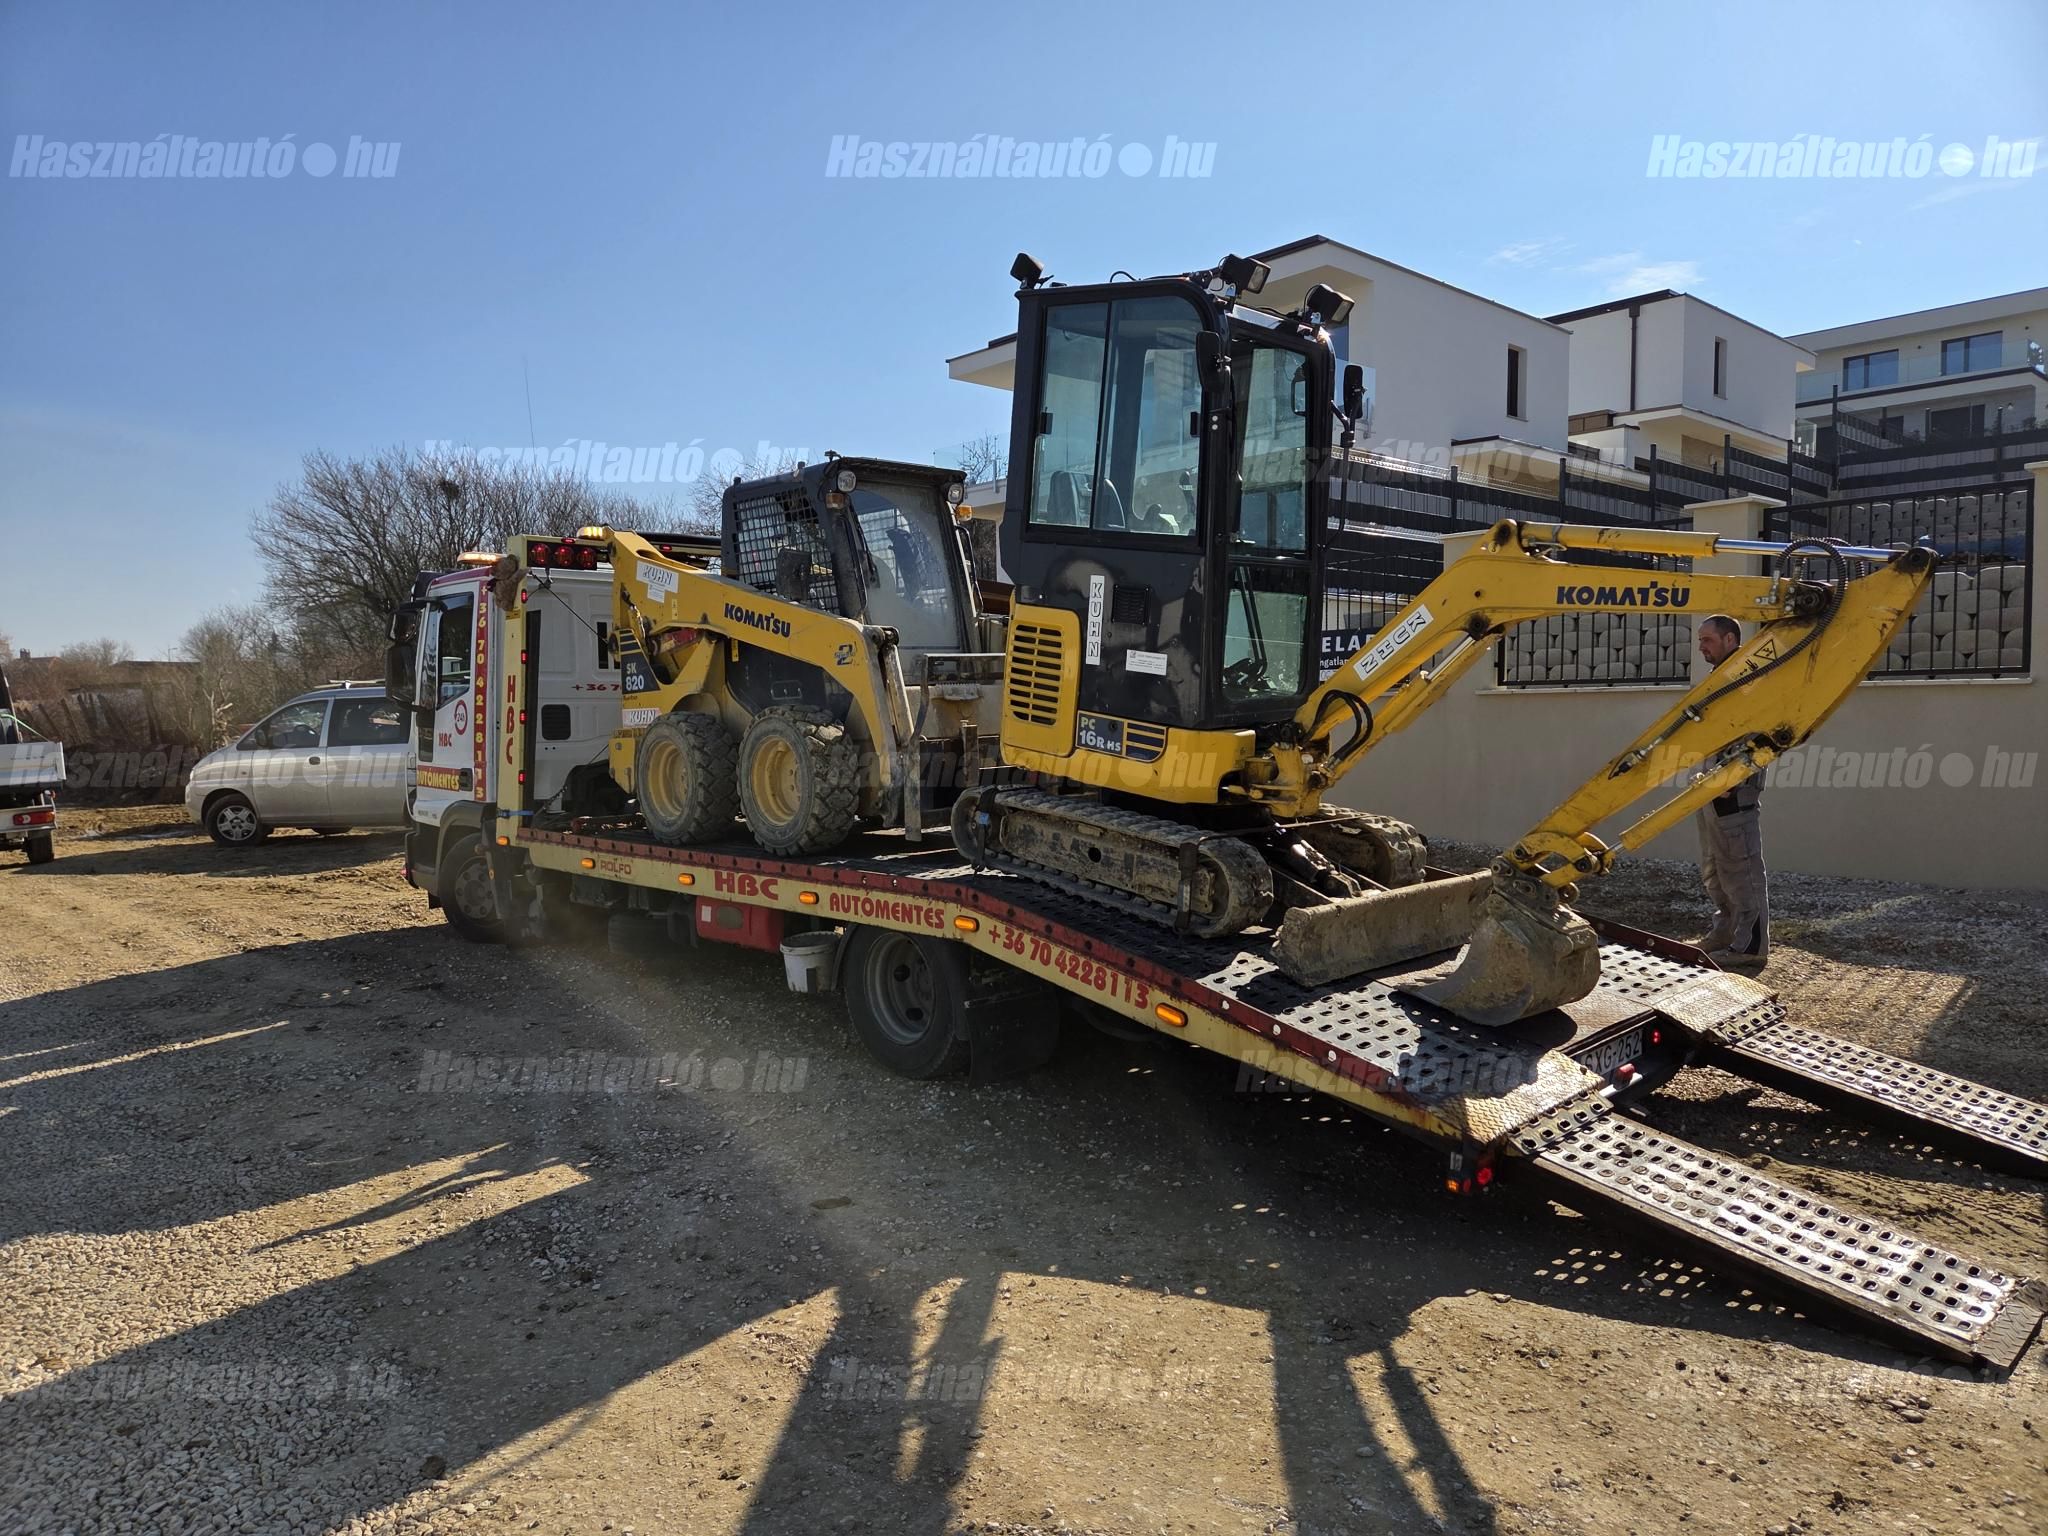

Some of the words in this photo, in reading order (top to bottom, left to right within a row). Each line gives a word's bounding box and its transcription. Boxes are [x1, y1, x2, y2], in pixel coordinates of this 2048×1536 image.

[643, 565, 673, 585] KUHN
[1557, 581, 1690, 607] KOMATSU
[724, 603, 791, 638] KOMATSU
[1087, 583, 1103, 658] KUHN
[1361, 611, 1427, 675] KUHN
[626, 662, 637, 674] SK
[625, 674, 645, 691] 820
[505, 675, 517, 766] HBC
[629, 709, 656, 723] KUHN
[1080, 717, 1096, 731] PC
[438, 733, 453, 747] HBC
[600, 860, 632, 875] ROLFO
[713, 871, 779, 901] HBC
[829, 891, 945, 930] AUTÓMENTÉS
[988, 925, 1026, 955] +36
[1029, 937, 1053, 966] 70
[1054, 949, 1151, 1010] 4228113
